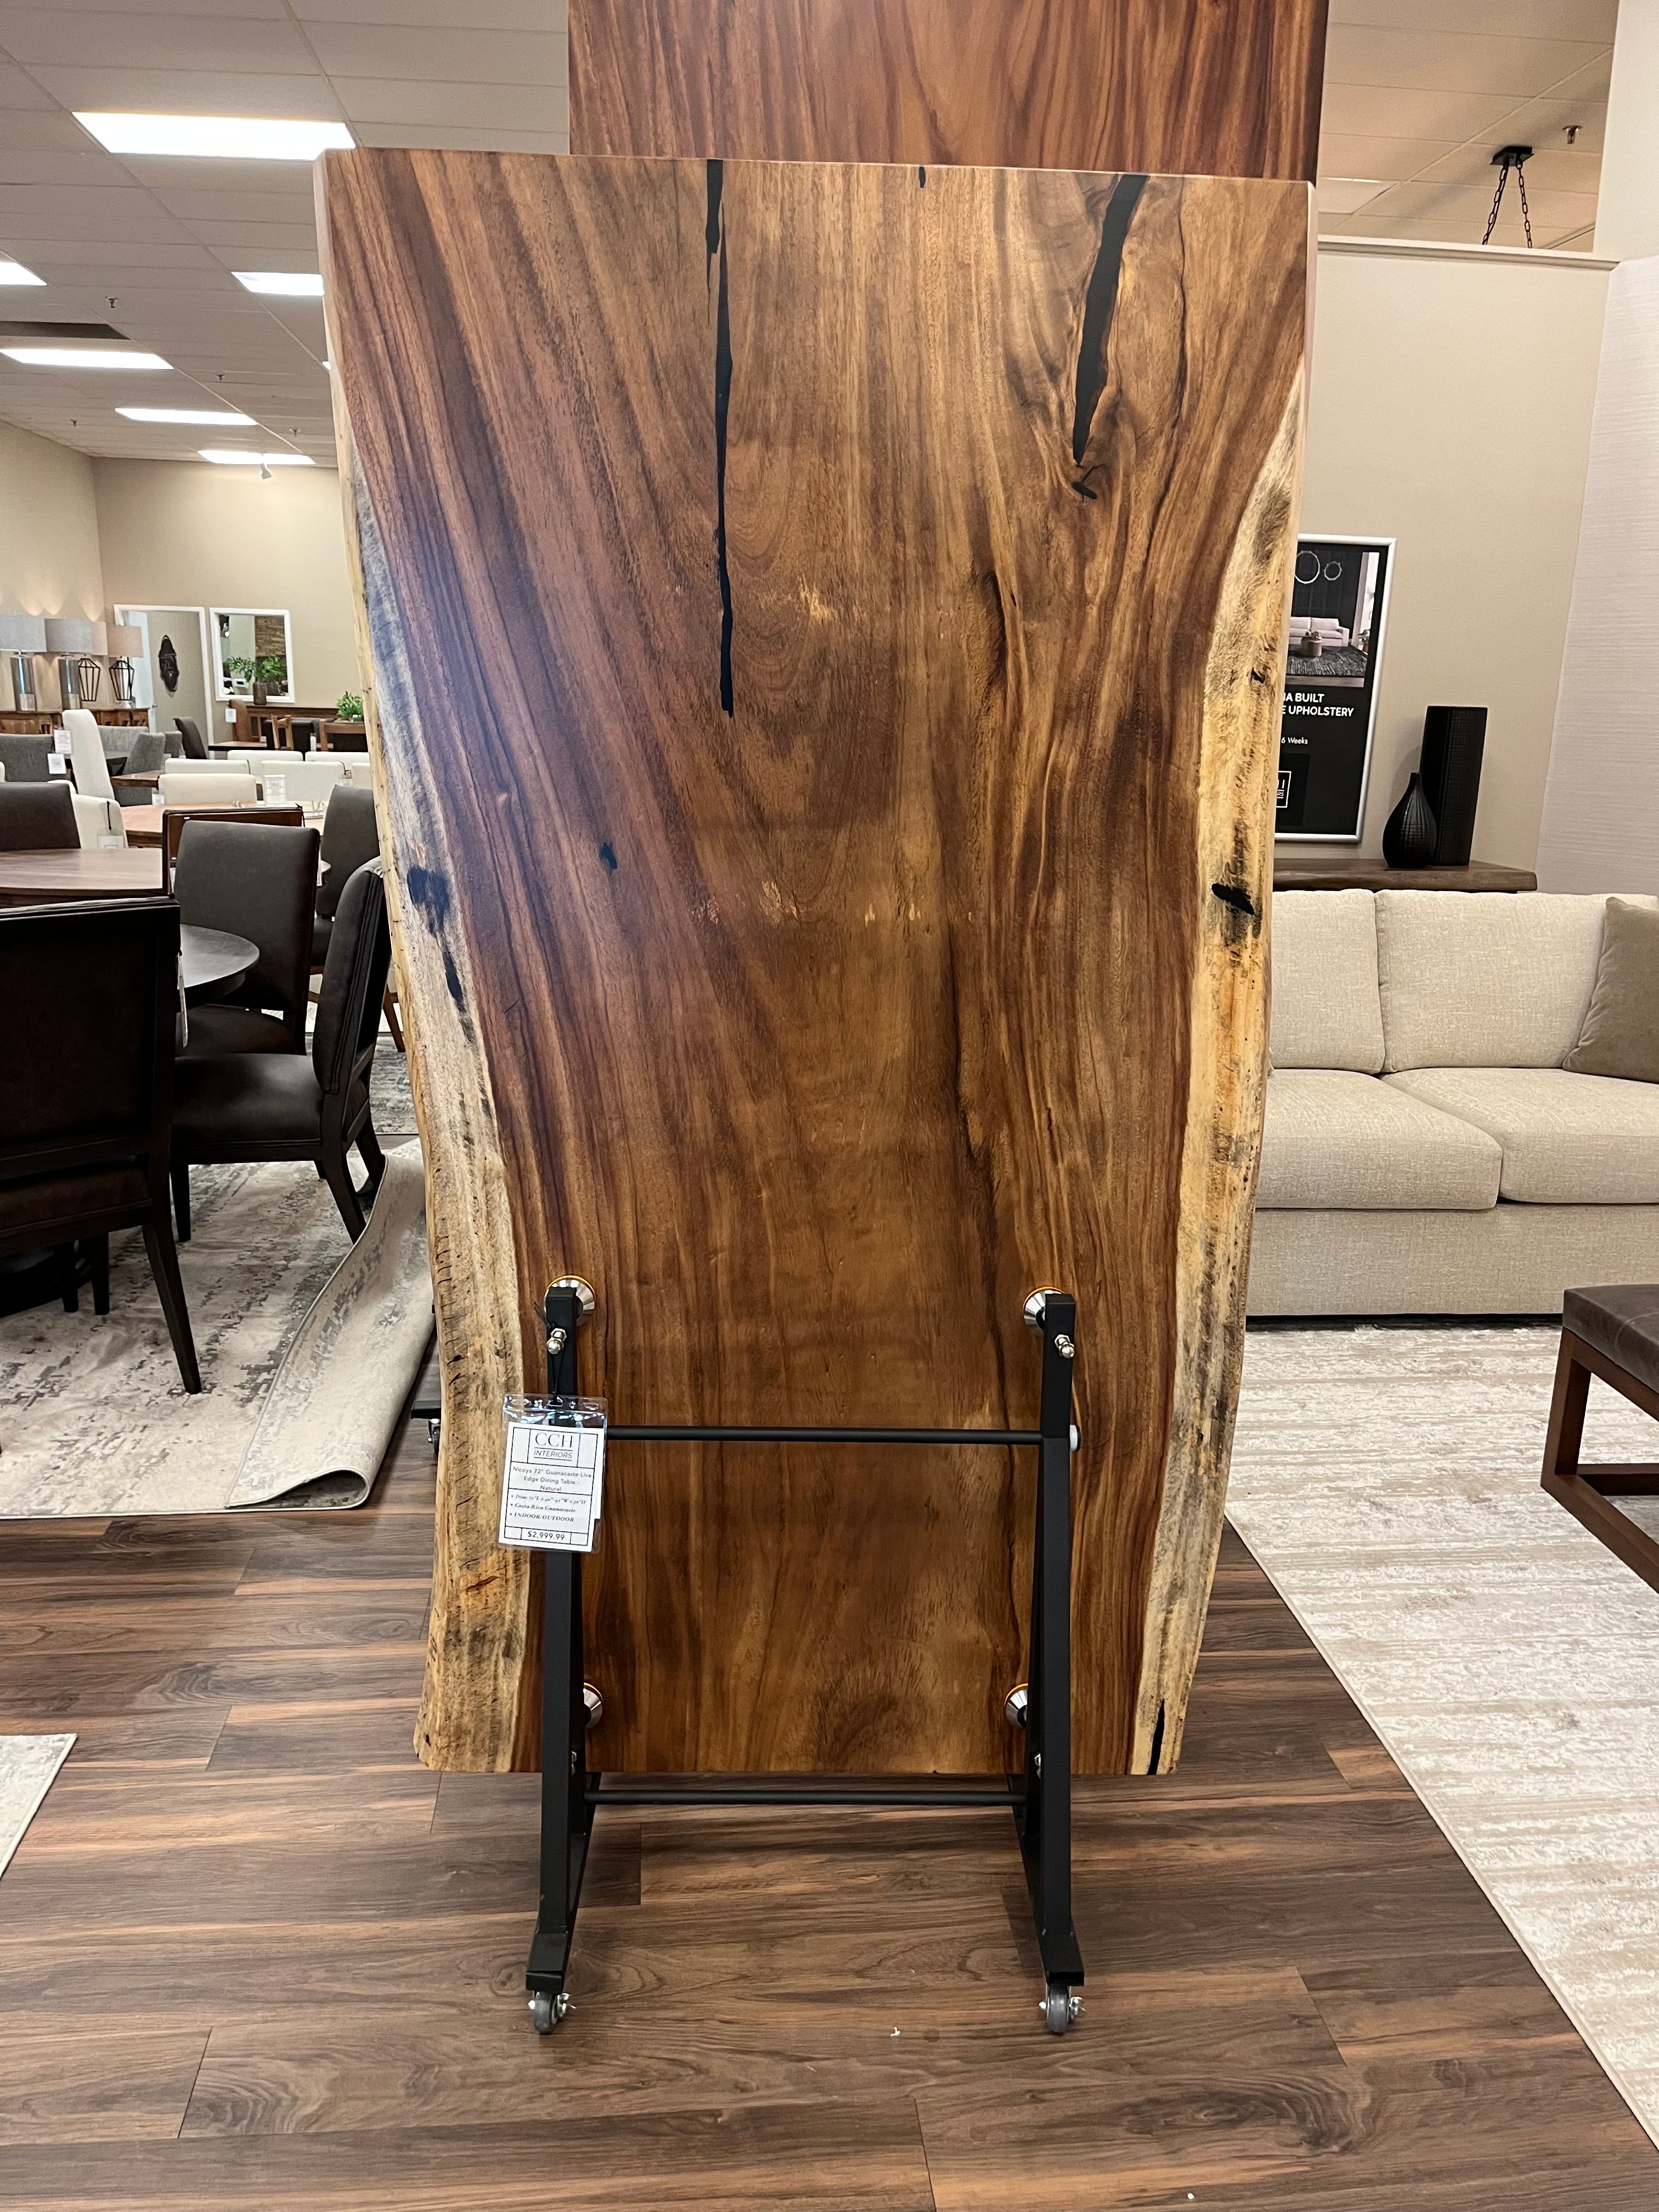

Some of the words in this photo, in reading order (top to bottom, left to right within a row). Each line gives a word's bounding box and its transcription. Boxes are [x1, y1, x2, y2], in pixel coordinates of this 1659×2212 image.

[1295, 692, 1325, 703] BUILT
[1288, 705, 1354, 716] UPHOLSTERY
[535, 1432, 573, 1448] CCH
[533, 1449, 572, 1459] INTERIORS
[514, 1512, 574, 1522] INDOOR/OUTDOOR
[528, 1531, 565, 1540] $2,999.99
